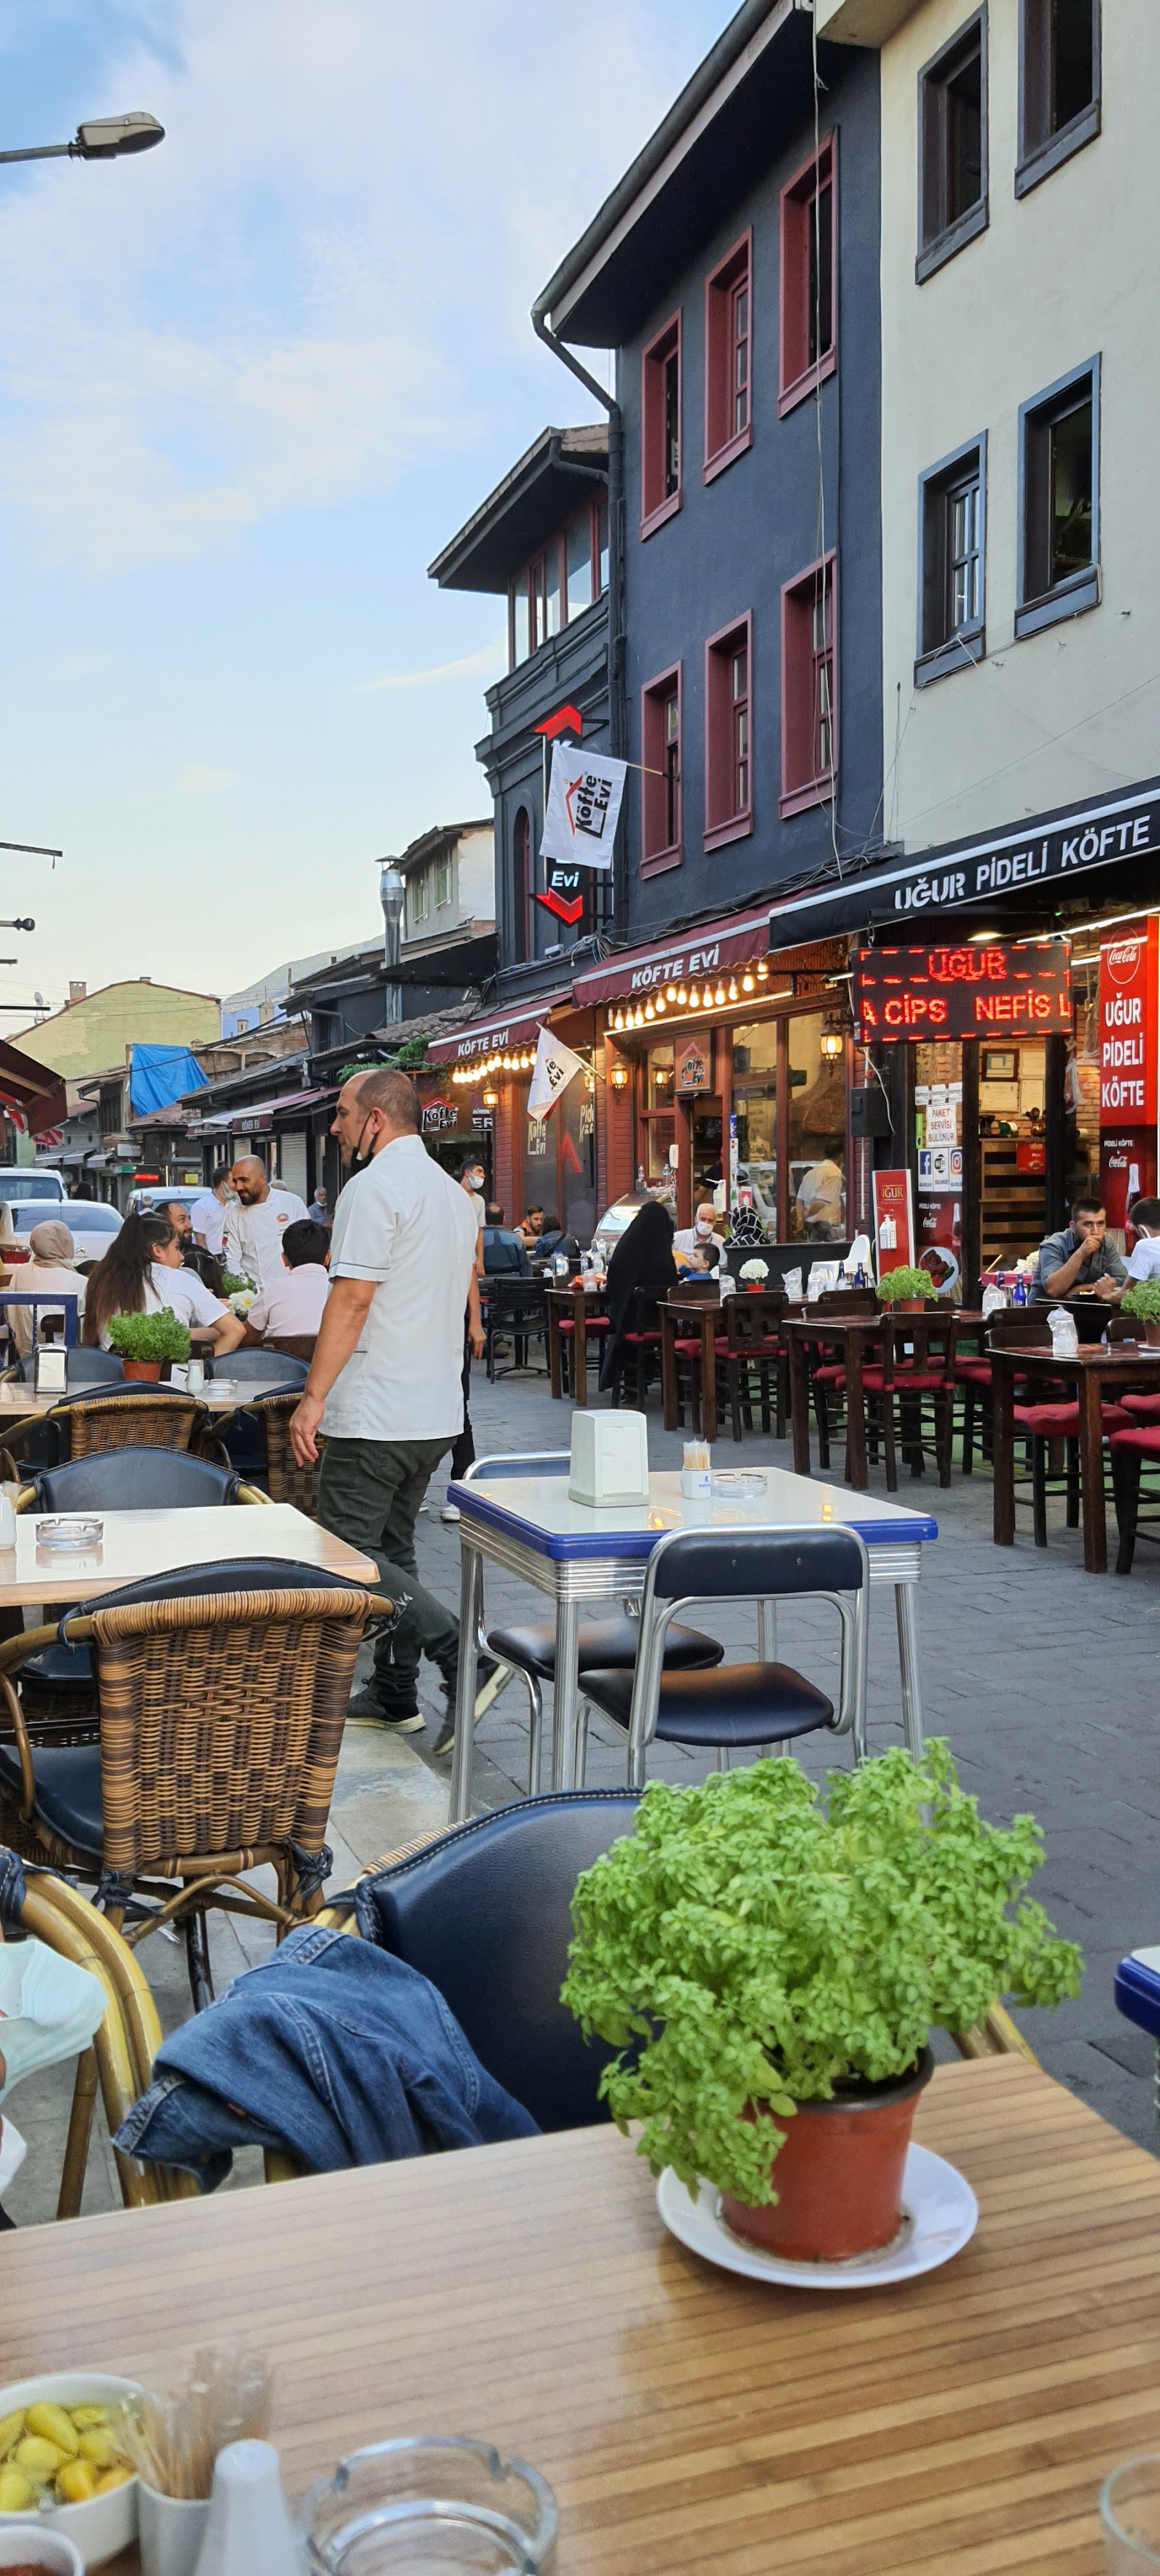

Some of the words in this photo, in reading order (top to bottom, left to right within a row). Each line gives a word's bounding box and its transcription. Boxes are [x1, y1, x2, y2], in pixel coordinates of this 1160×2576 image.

[575, 775, 602, 839] Köfte
[593, 778, 613, 812] Evi
[895, 872, 966, 909] UĞUR
[976, 841, 1048, 891] PİDELİ
[1061, 814, 1151, 867] KÖFTE
[551, 870, 580, 888] Evi
[631, 959, 684, 988] KÖFTE
[688, 944, 720, 972] EVİ
[884, 991, 947, 1024] CİPS
[975, 989, 1051, 1021] NEFİS
[1105, 992, 1142, 1027] UĞUR
[457, 1036, 489, 1057] KÖFTE
[492, 1027, 509, 1048] EVİ
[1103, 1032, 1143, 1068] PİDELİ
[1101, 1076, 1145, 1108] KÖFTE
[423, 1106, 458, 1129] Köfte
[932, 1108, 950, 1118] PAKET
[928, 1133, 954, 1142] BULUNUR
